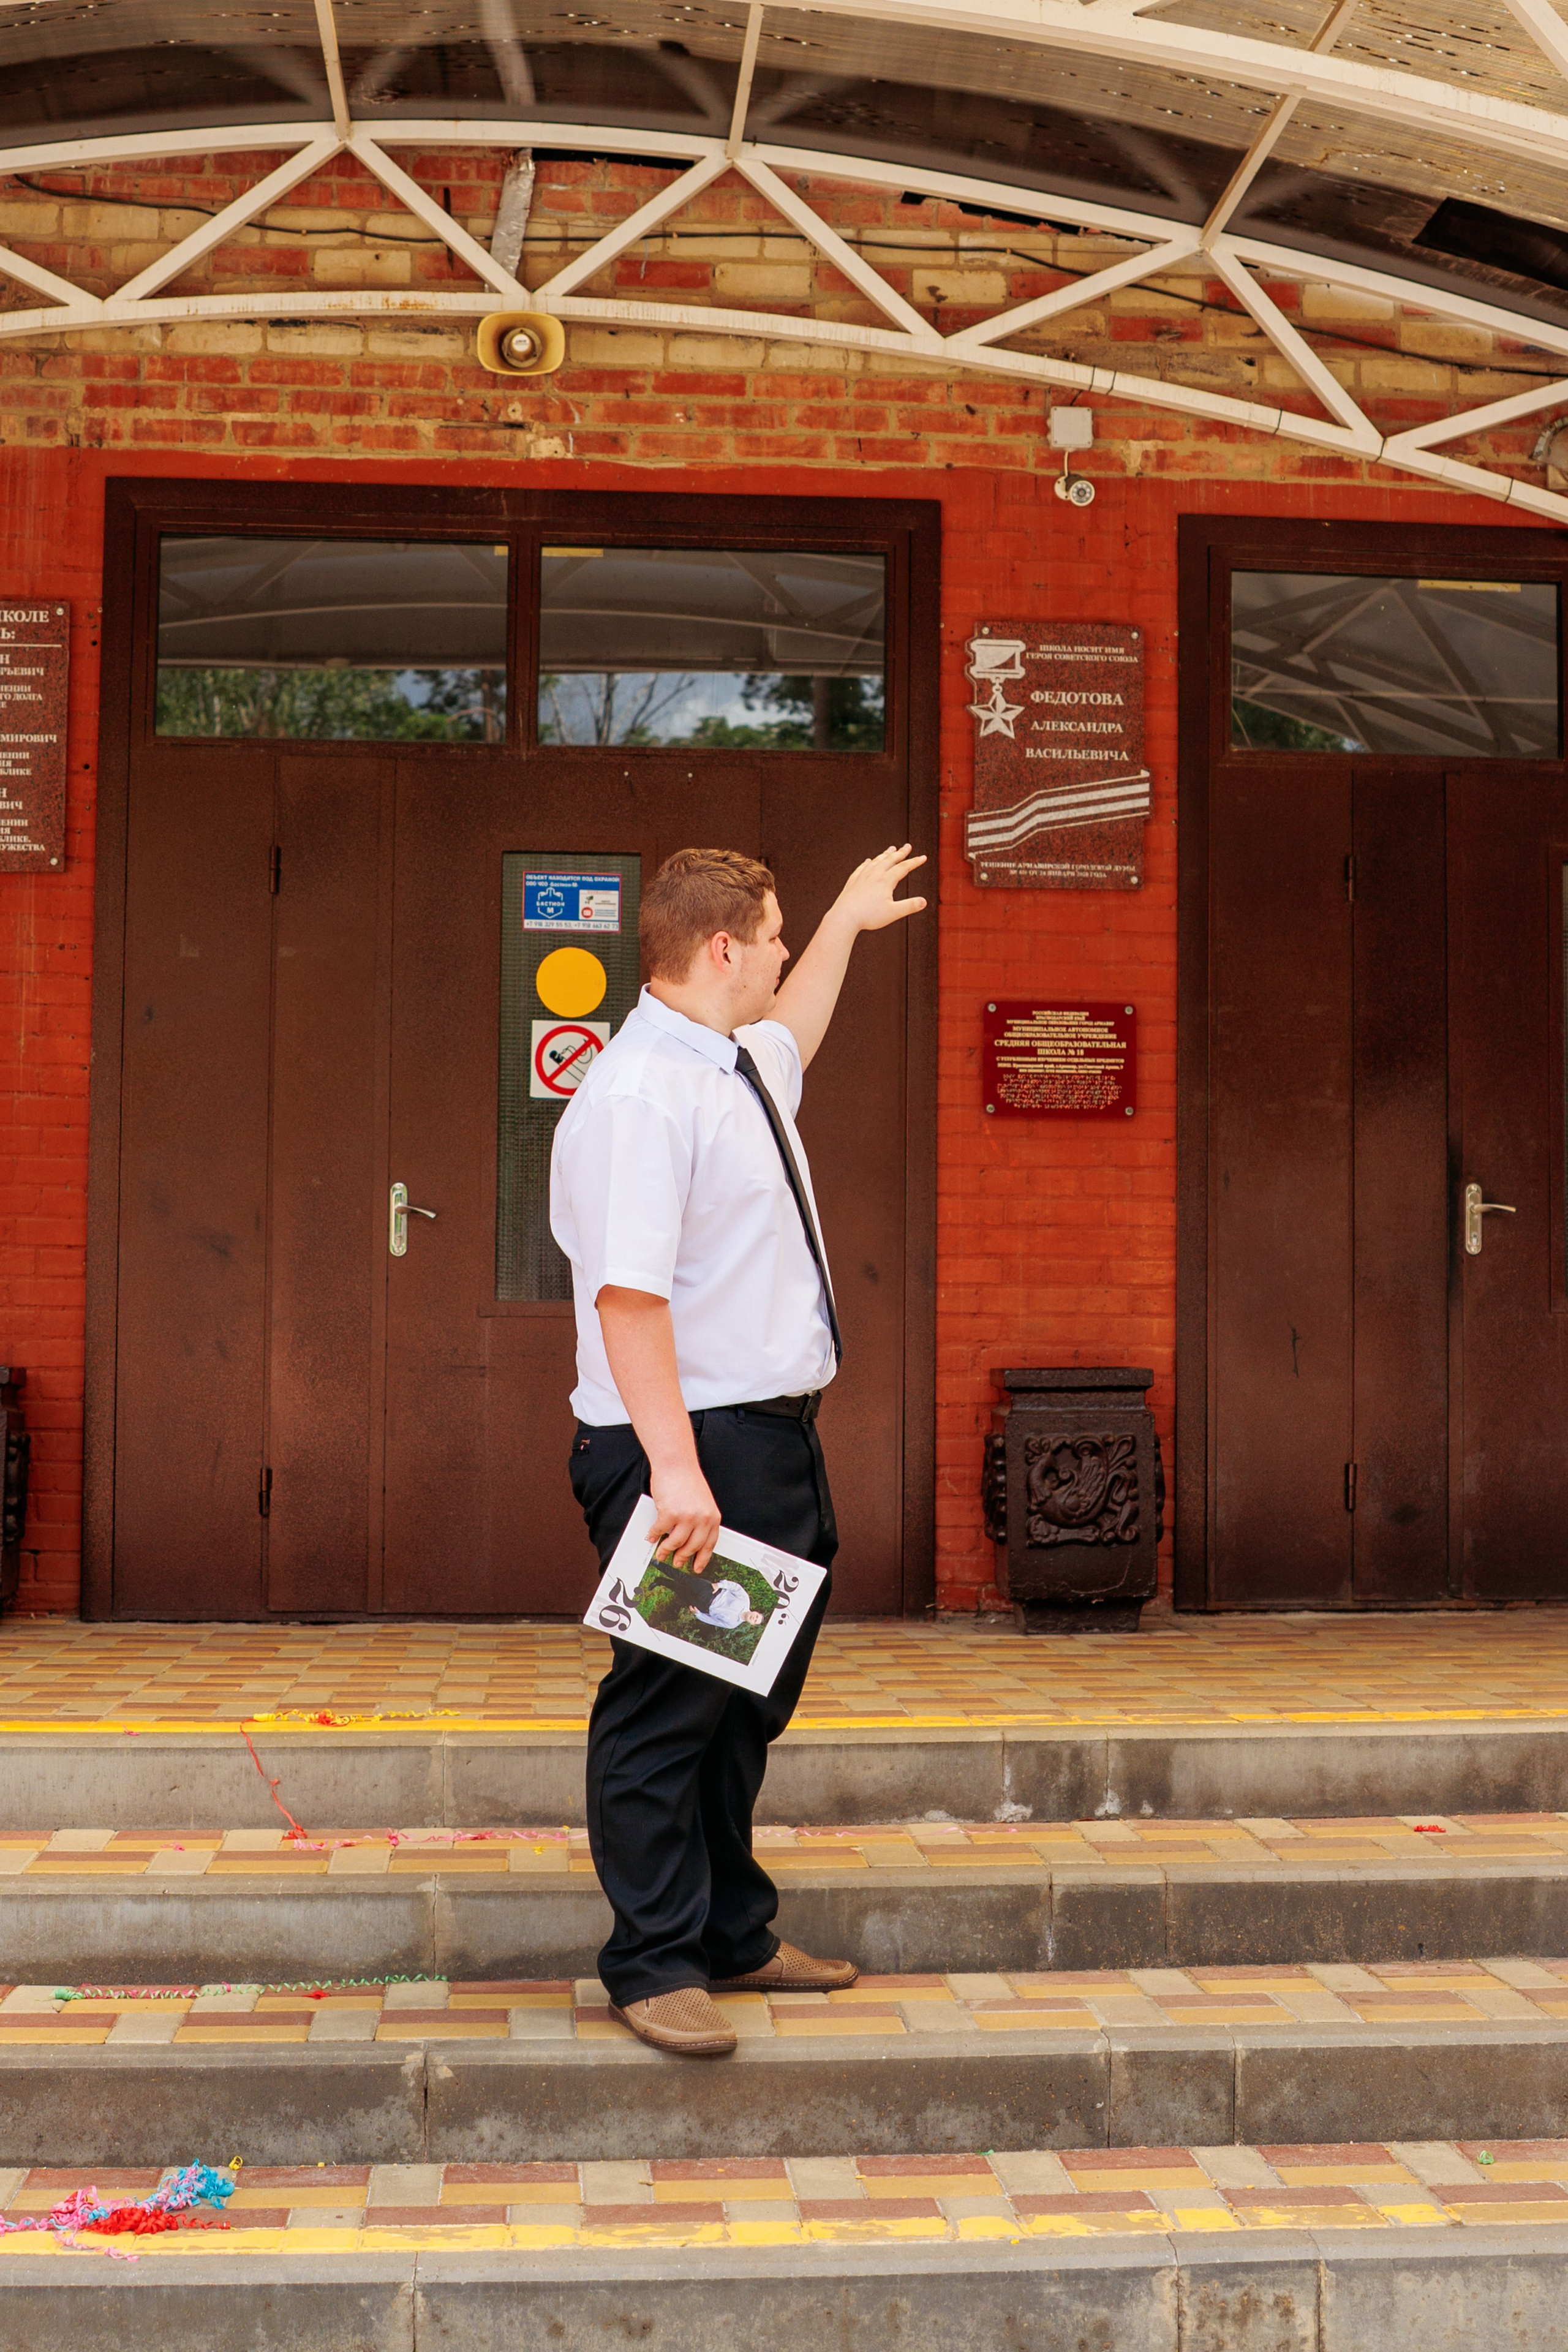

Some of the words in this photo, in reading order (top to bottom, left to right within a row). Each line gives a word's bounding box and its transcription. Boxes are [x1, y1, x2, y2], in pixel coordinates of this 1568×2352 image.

[0, 610, 49, 622] КОЛЕ
[1054, 654, 1107, 662] СОВЕТСКОГО
[1030, 690, 1125, 706] ФЕДОТОВА
[1030, 720, 1124, 734] АЛЕКСАНДРА
[1025, 747, 1129, 761] ВАСИЛЬЕВИЧА
[599, 1577, 643, 1631] 26
